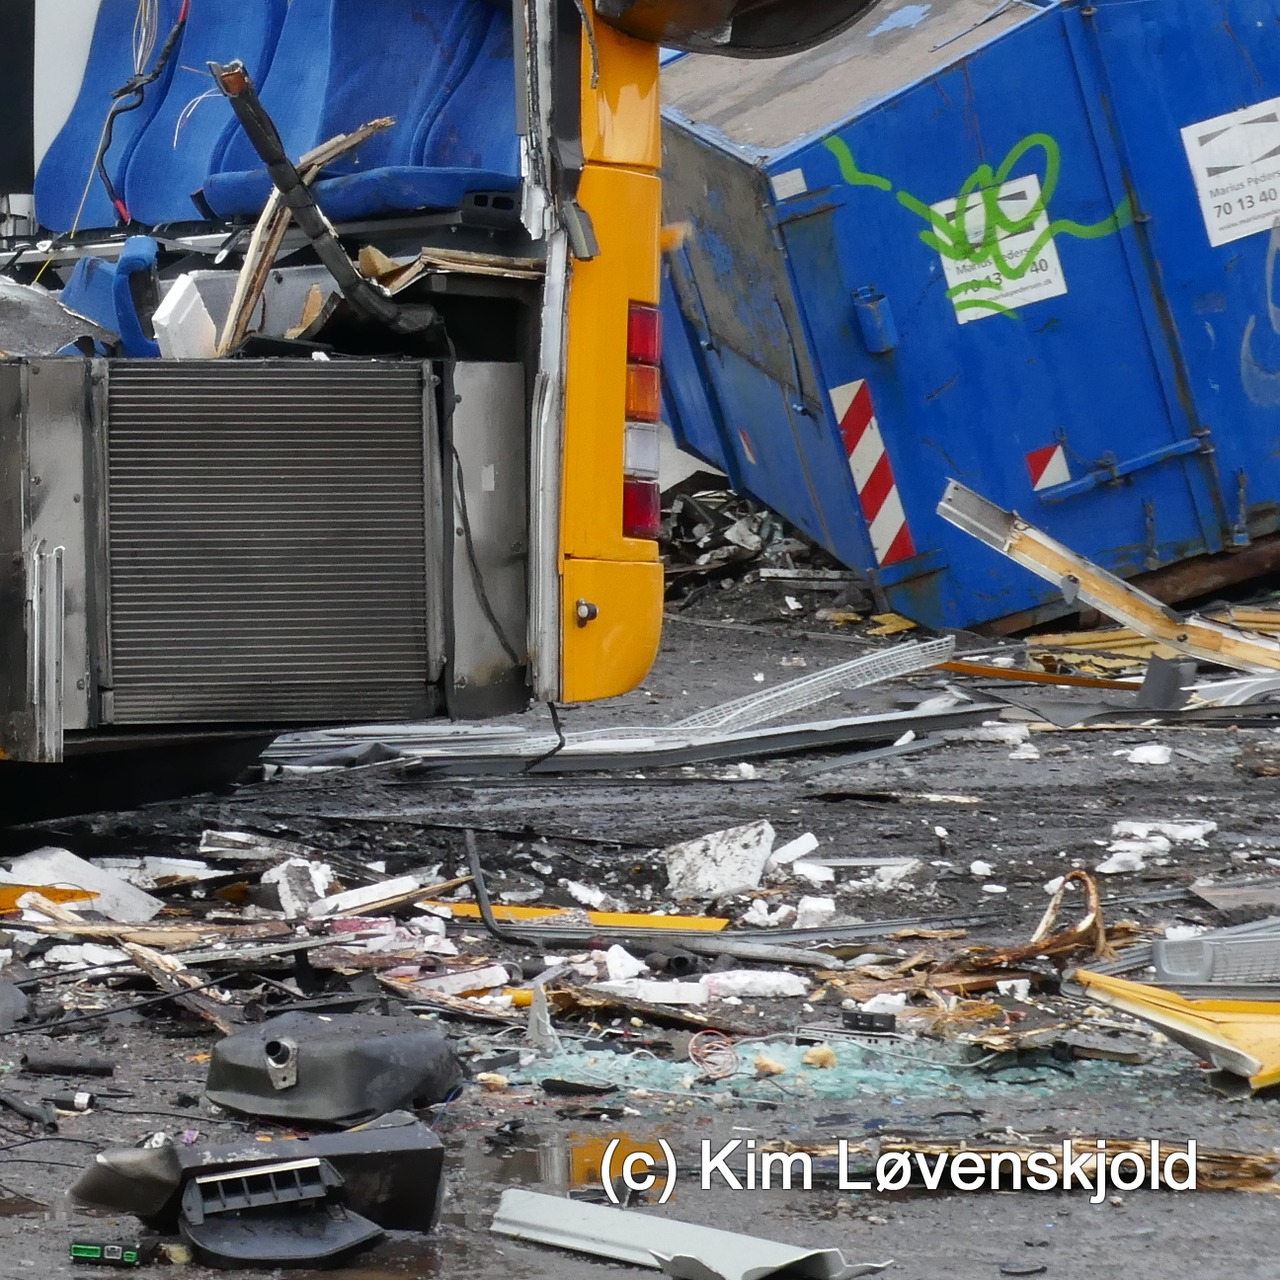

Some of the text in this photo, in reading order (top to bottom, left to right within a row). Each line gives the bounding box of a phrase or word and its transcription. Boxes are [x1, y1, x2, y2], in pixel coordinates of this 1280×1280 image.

[1209, 179, 1246, 199] Marius
[1213, 187, 1278, 218] 70 13 40
[1030, 258, 1049, 274] 40
